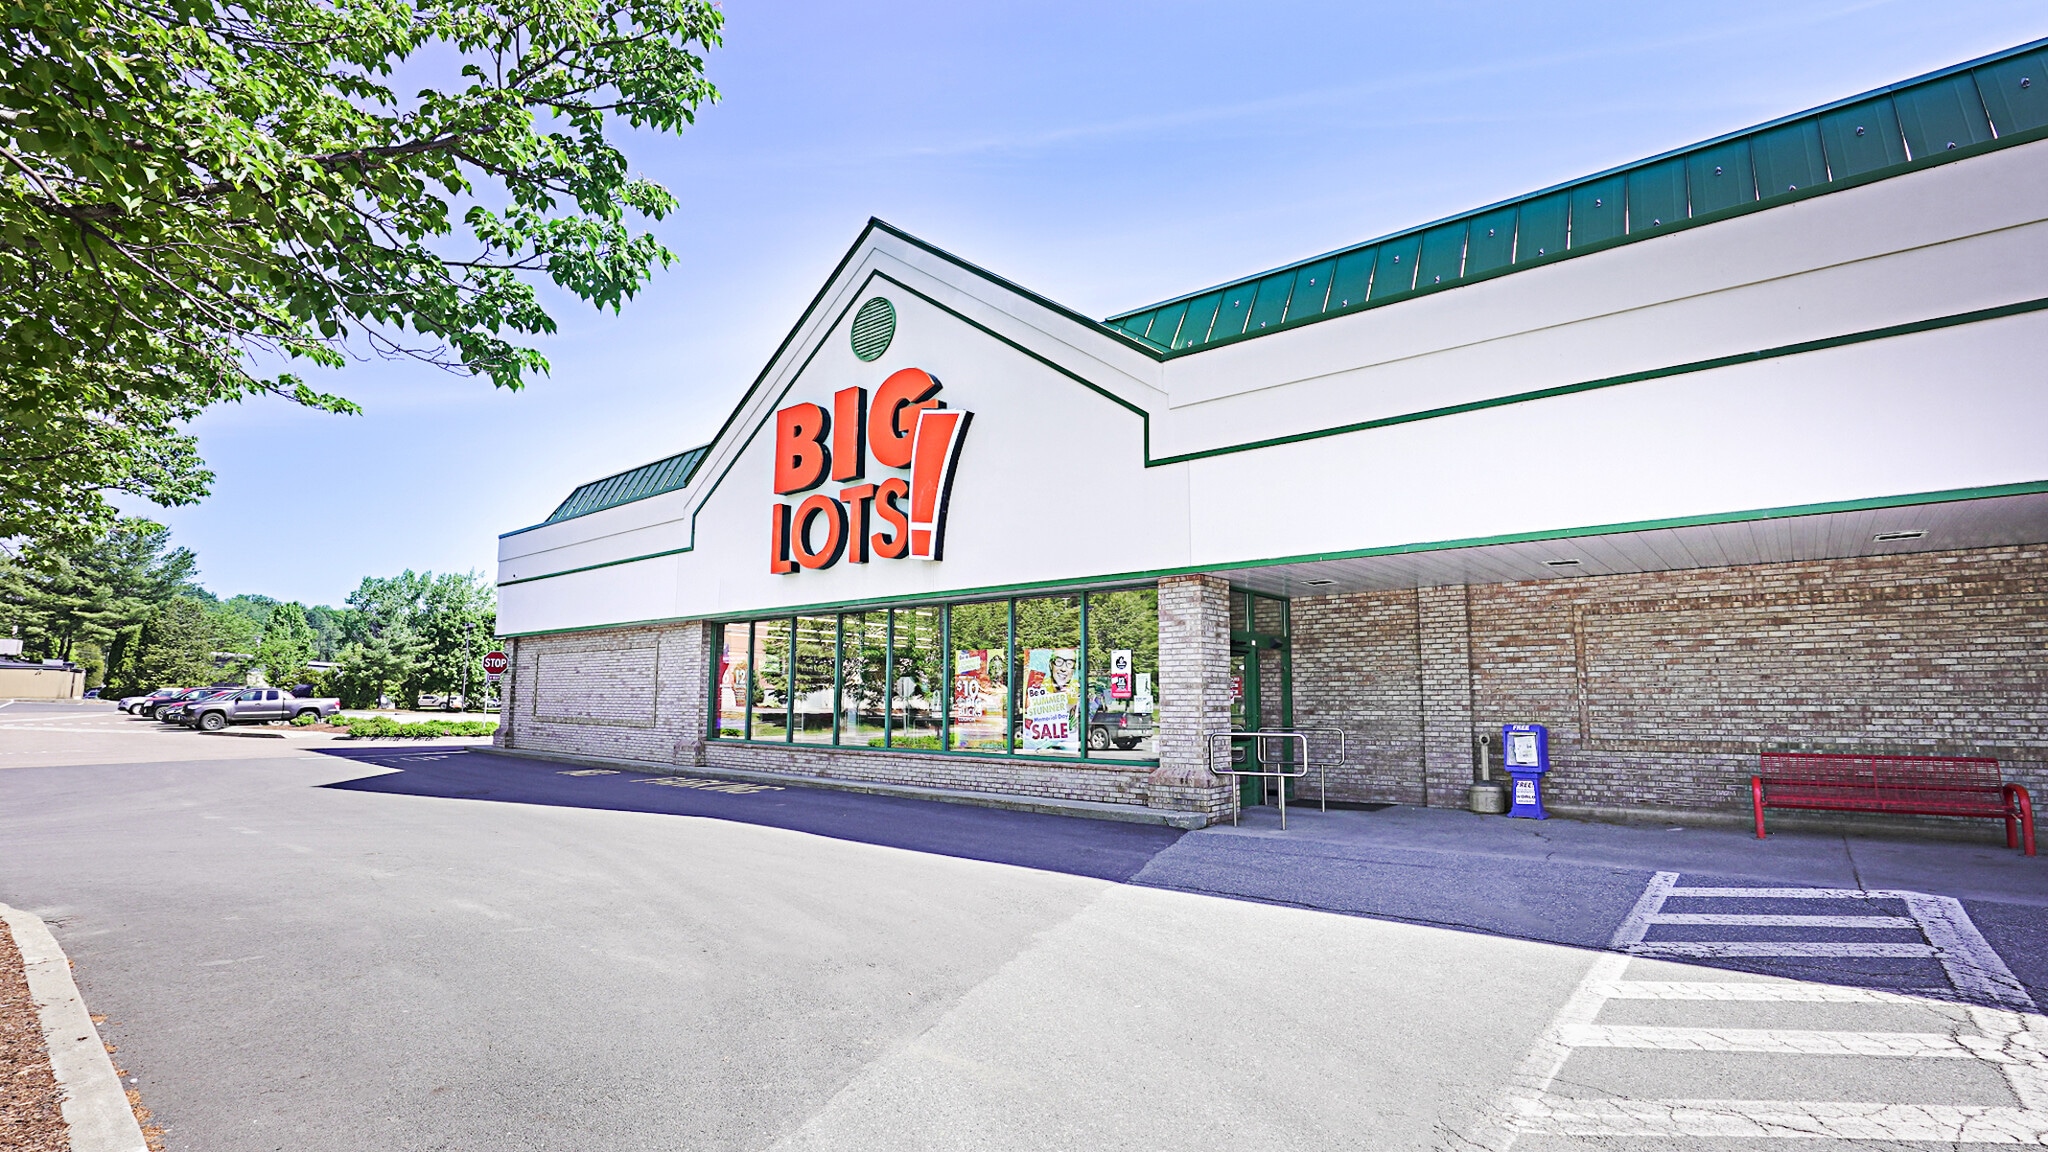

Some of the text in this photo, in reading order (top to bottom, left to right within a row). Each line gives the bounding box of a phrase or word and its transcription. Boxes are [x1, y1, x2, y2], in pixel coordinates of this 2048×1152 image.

[773, 367, 946, 495] BIG
[484, 658, 507, 668] STOP
[956, 680, 979, 697] $10
[1032, 694, 1066, 706] SUMMER
[1028, 703, 1066, 716] STUNNER
[1033, 713, 1069, 722] Memorial Day
[1032, 723, 1068, 739] SALE
